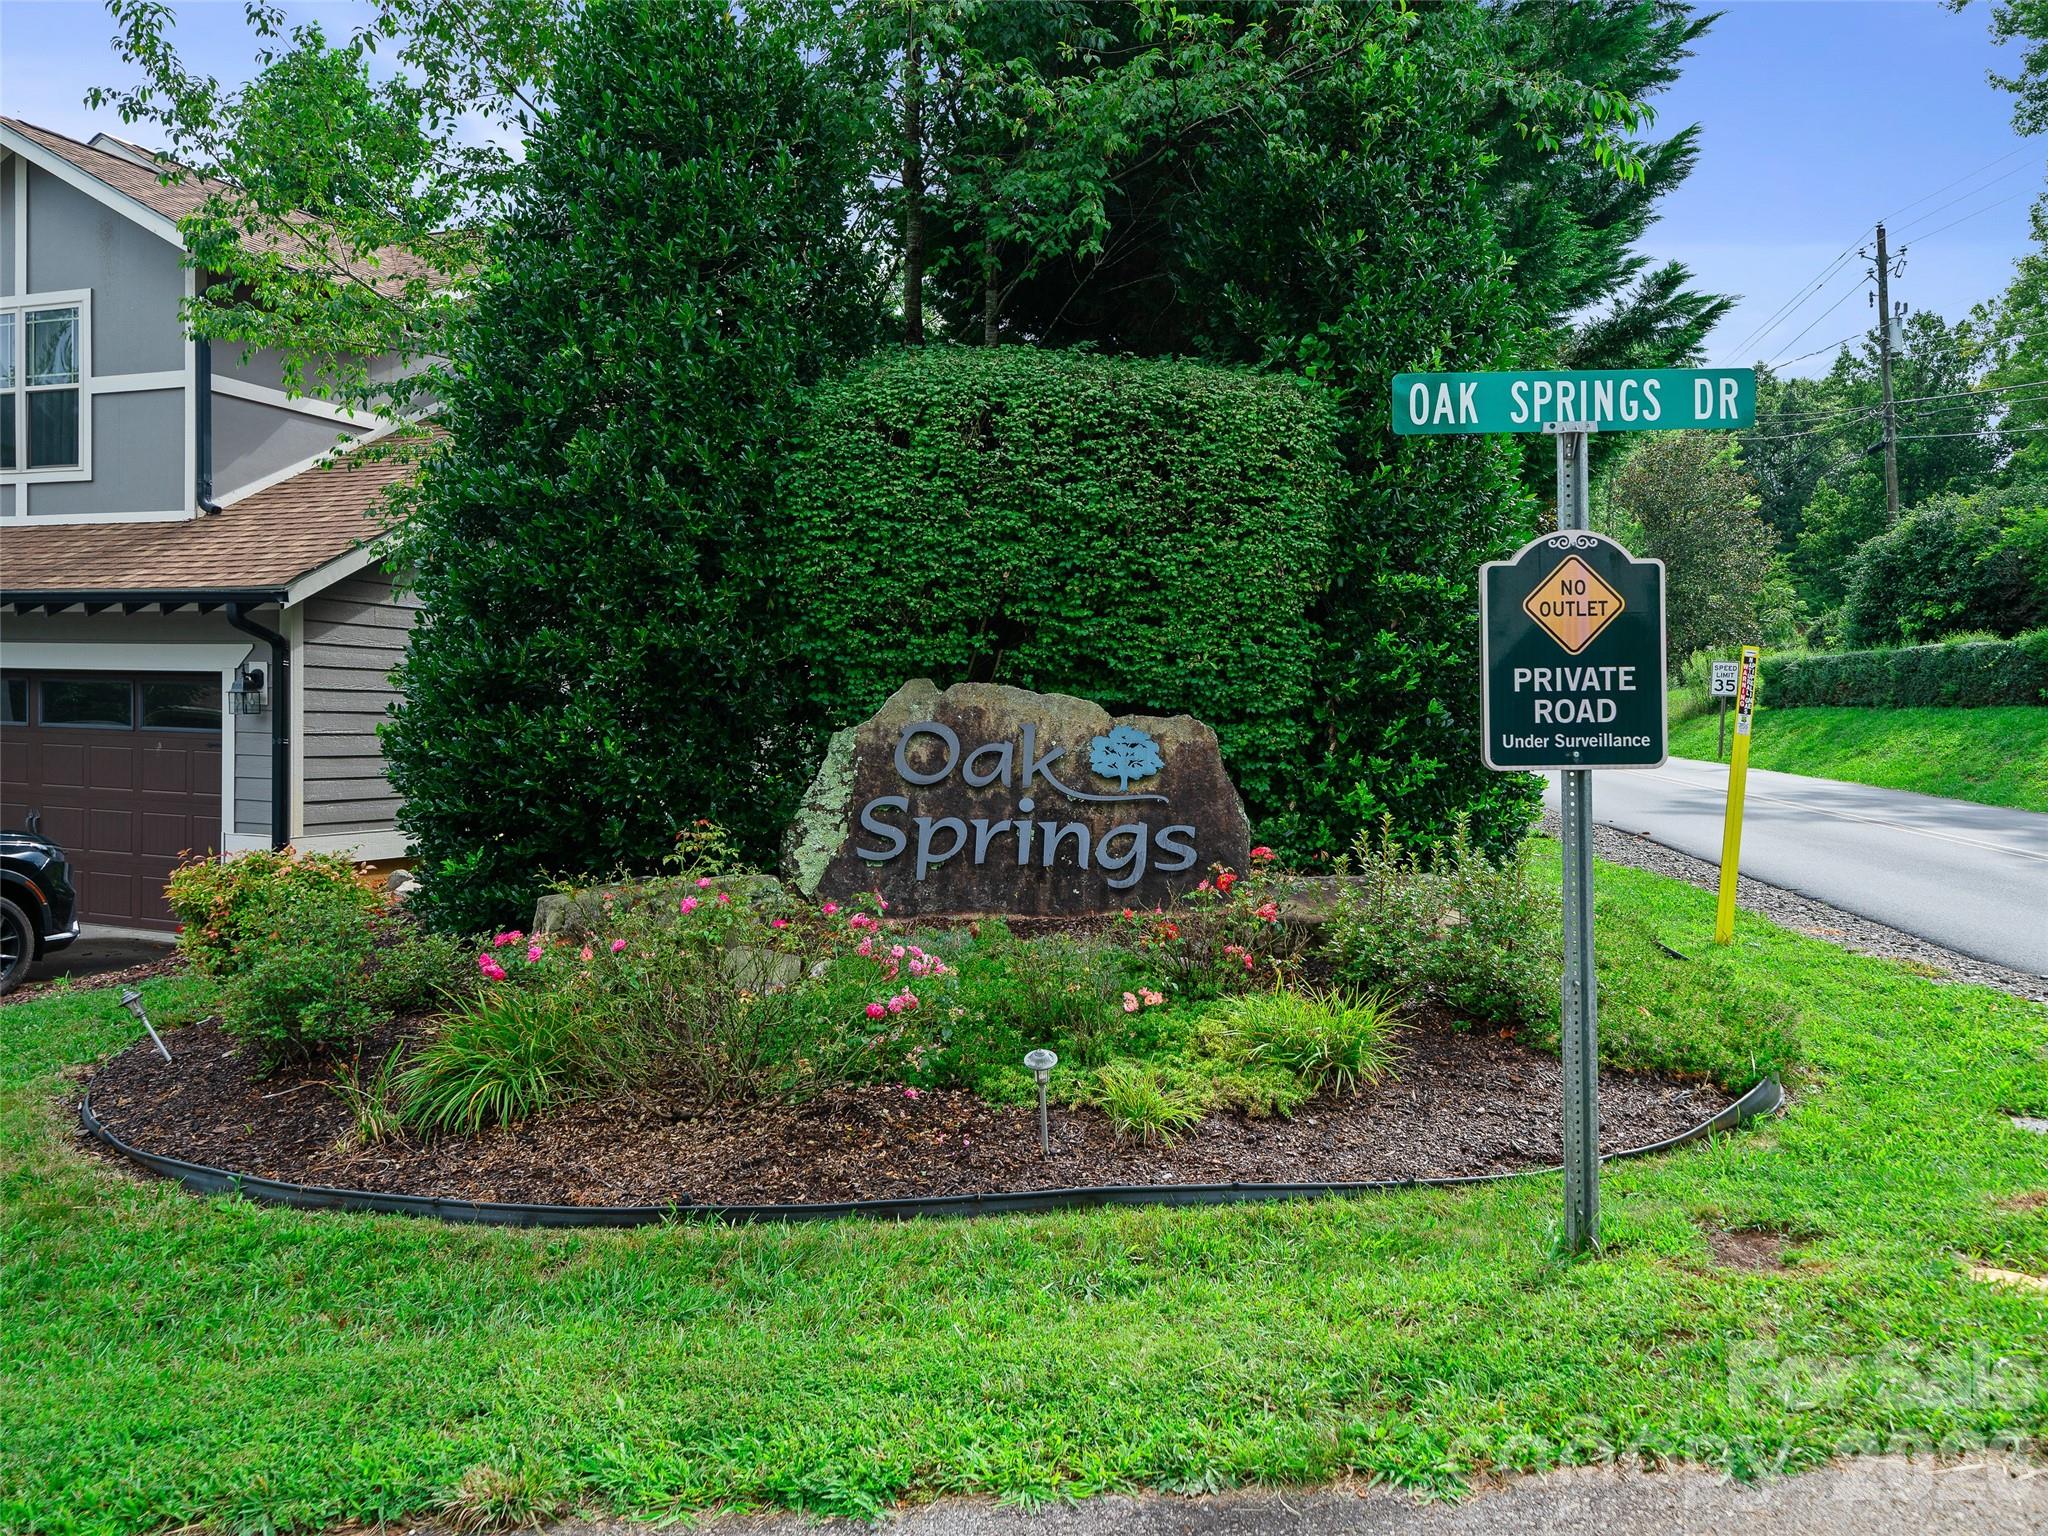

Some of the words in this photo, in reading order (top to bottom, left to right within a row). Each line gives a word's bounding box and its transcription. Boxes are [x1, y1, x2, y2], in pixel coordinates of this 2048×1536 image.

[1409, 382, 1479, 425] OAK
[1509, 378, 1661, 424] SPRINGS
[1693, 377, 1739, 420] DR
[1560, 579, 1586, 596] NO
[1539, 600, 1609, 617] OUTLET
[1513, 666, 1637, 693] PRIVATE
[1714, 664, 1737, 672] SPEED
[1714, 679, 1736, 692] 35
[1739, 664, 1749, 707] WARNING
[1534, 698, 1617, 724] ROAD
[1502, 733, 1549, 749] Under
[1554, 732, 1651, 748] Surveillance
[894, 721, 1168, 803] Oak
[856, 795, 1198, 889] Springs
